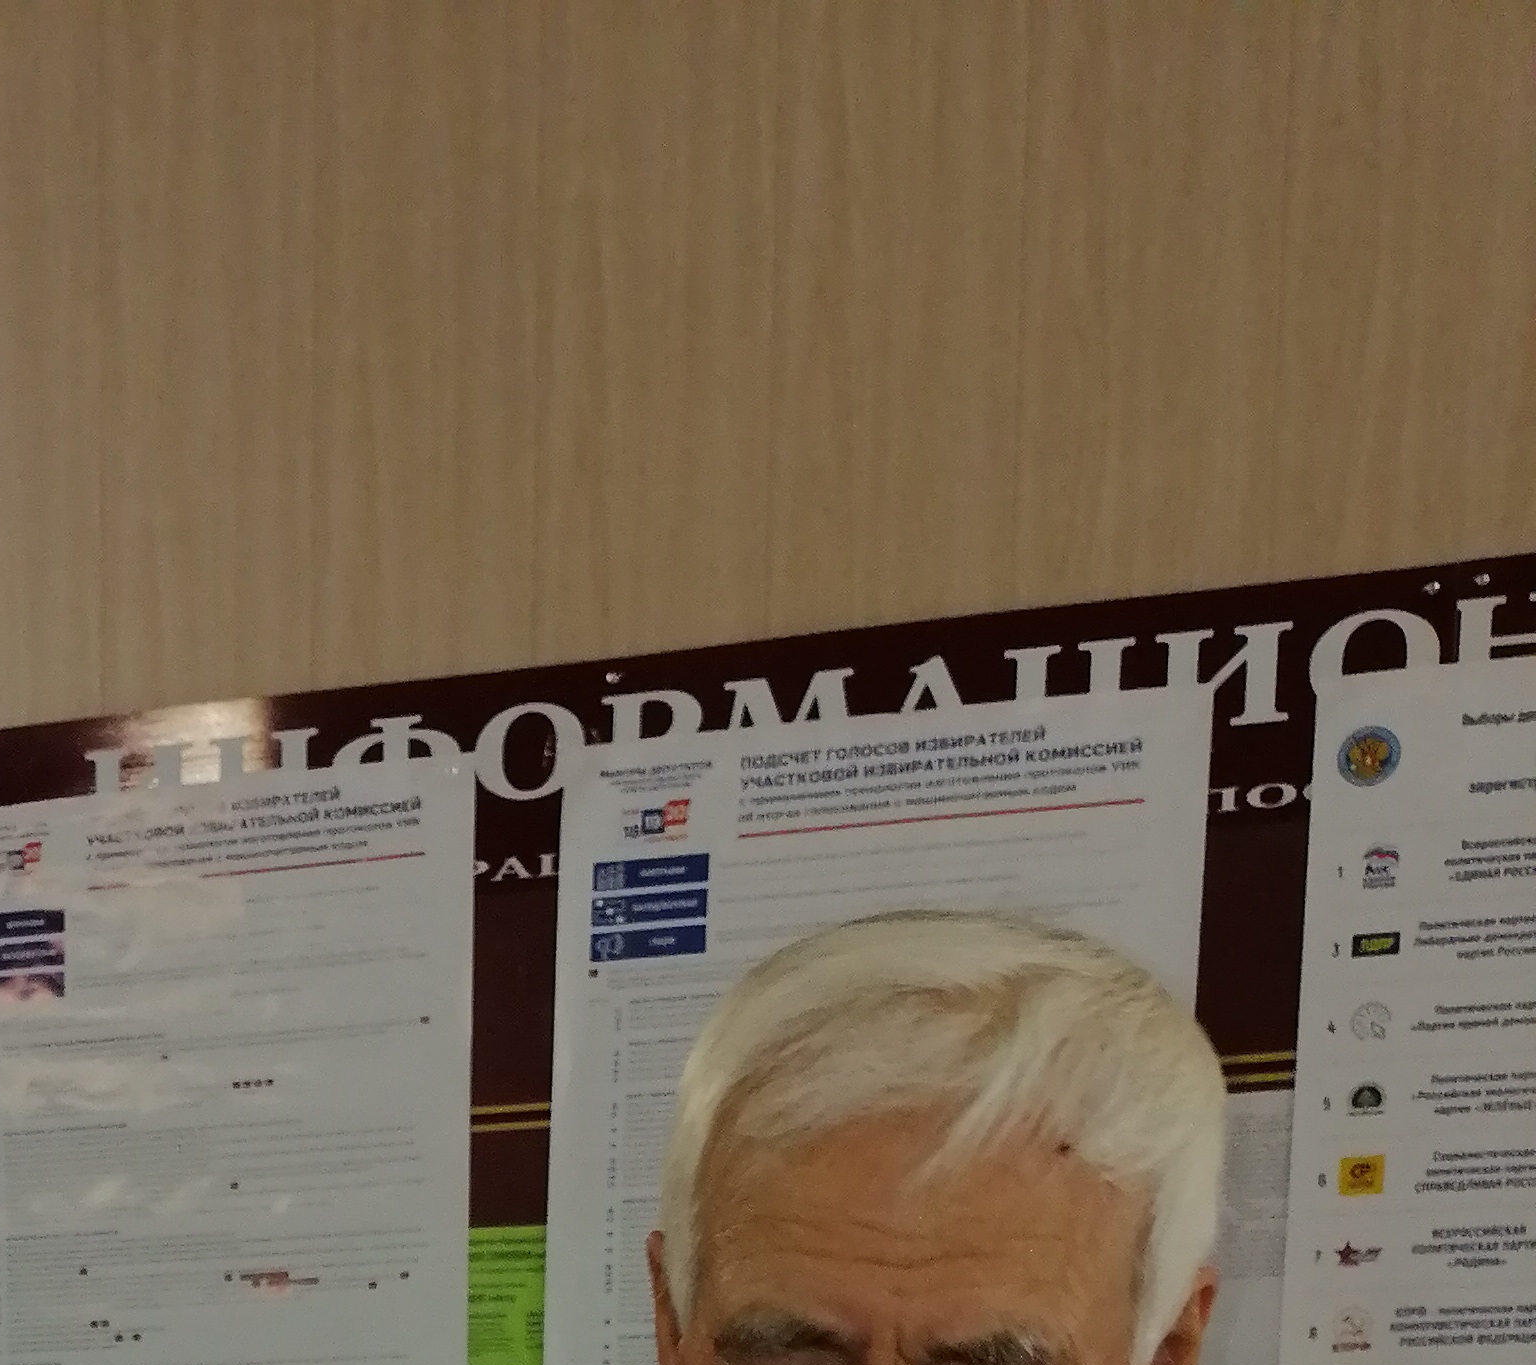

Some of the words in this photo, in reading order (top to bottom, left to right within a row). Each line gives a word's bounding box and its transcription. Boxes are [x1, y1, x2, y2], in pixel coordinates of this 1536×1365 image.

[740, 763, 859, 791] УЧАСТКОВОЙ
[863, 749, 1020, 778] ИЗБИРАТЕЛЬНОЙ
[1025, 738, 1144, 763] КОМИССИЕЙ
[826, 740, 910, 763] ГОЛОСОВ
[915, 725, 1046, 753] ИЗБИРАТЕЛЕЙ
